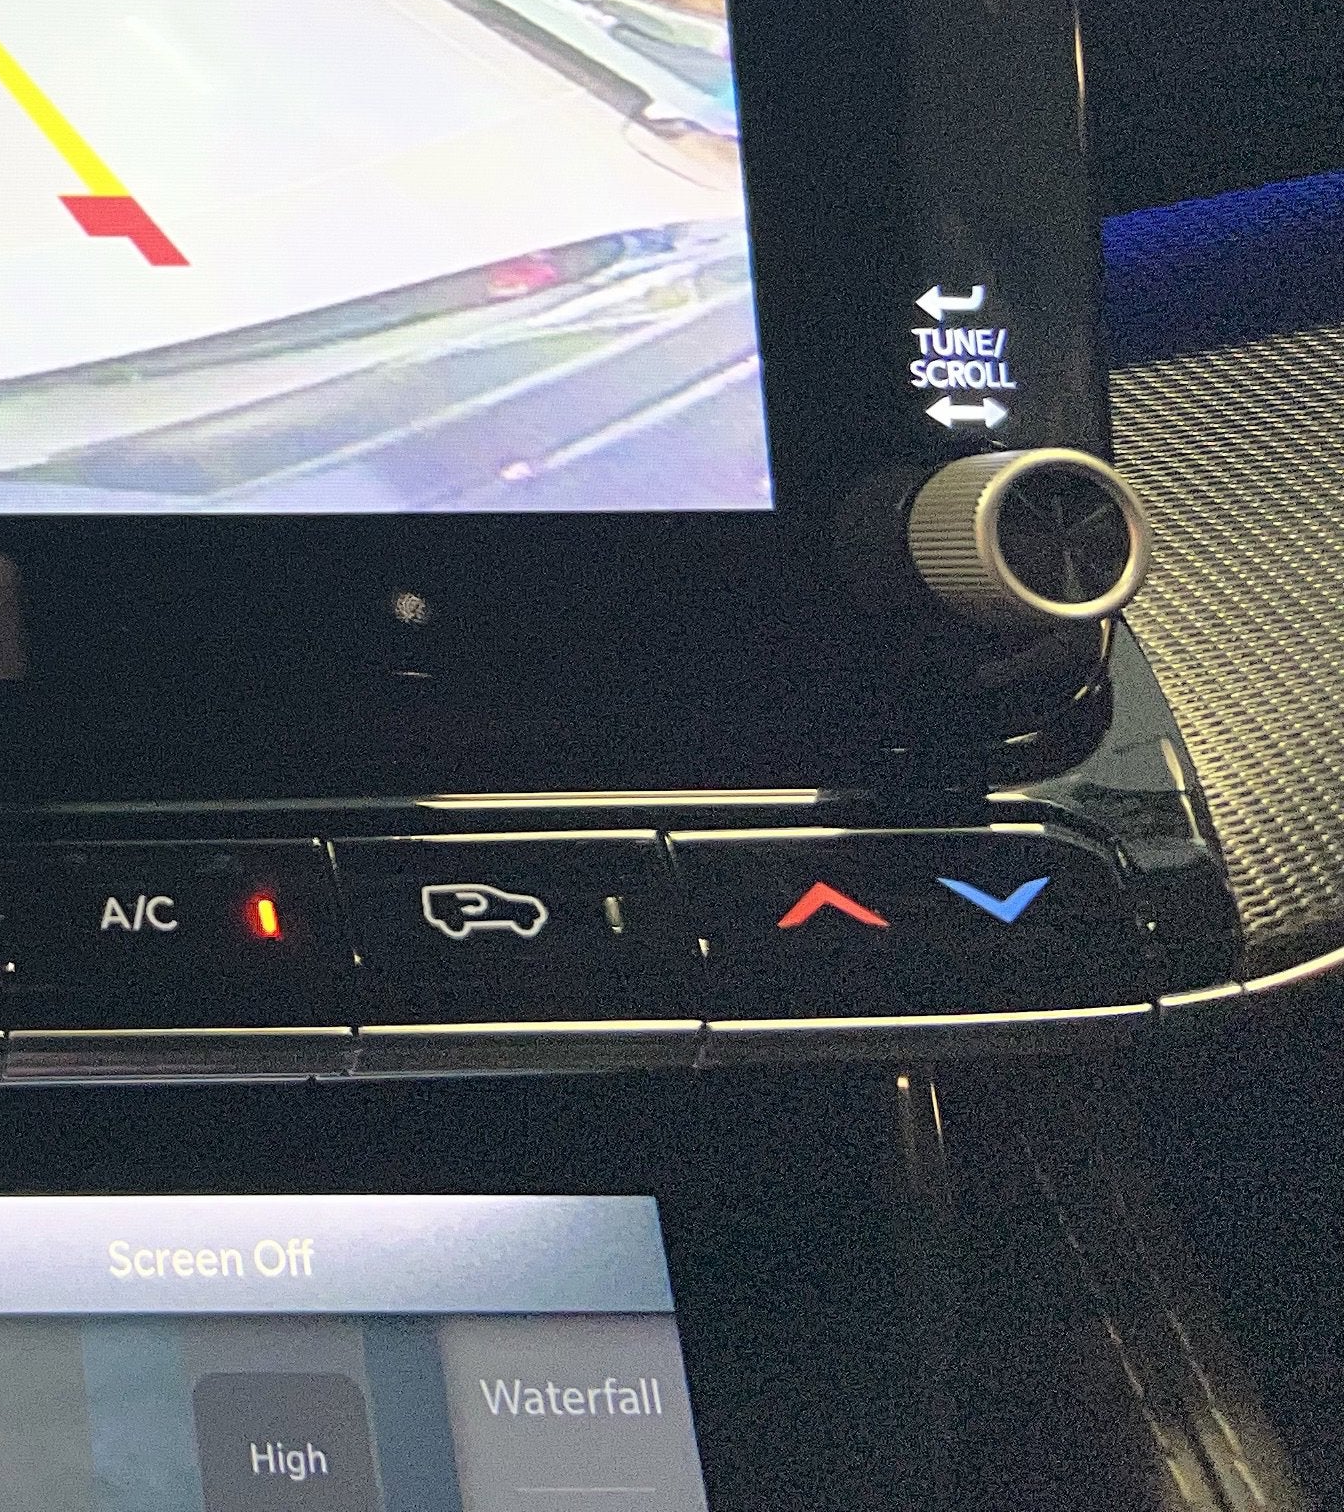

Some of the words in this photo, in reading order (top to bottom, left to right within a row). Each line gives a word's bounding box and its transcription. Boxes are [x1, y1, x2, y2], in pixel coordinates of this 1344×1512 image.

[912, 328, 1007, 357] TUNE/
[910, 360, 1017, 388] SCROLL
[100, 896, 178, 932] A/C
[108, 1240, 244, 1278] Screen
[254, 1238, 316, 1278] Off
[481, 1378, 662, 1417] Waterfall
[250, 1442, 328, 1480] High
